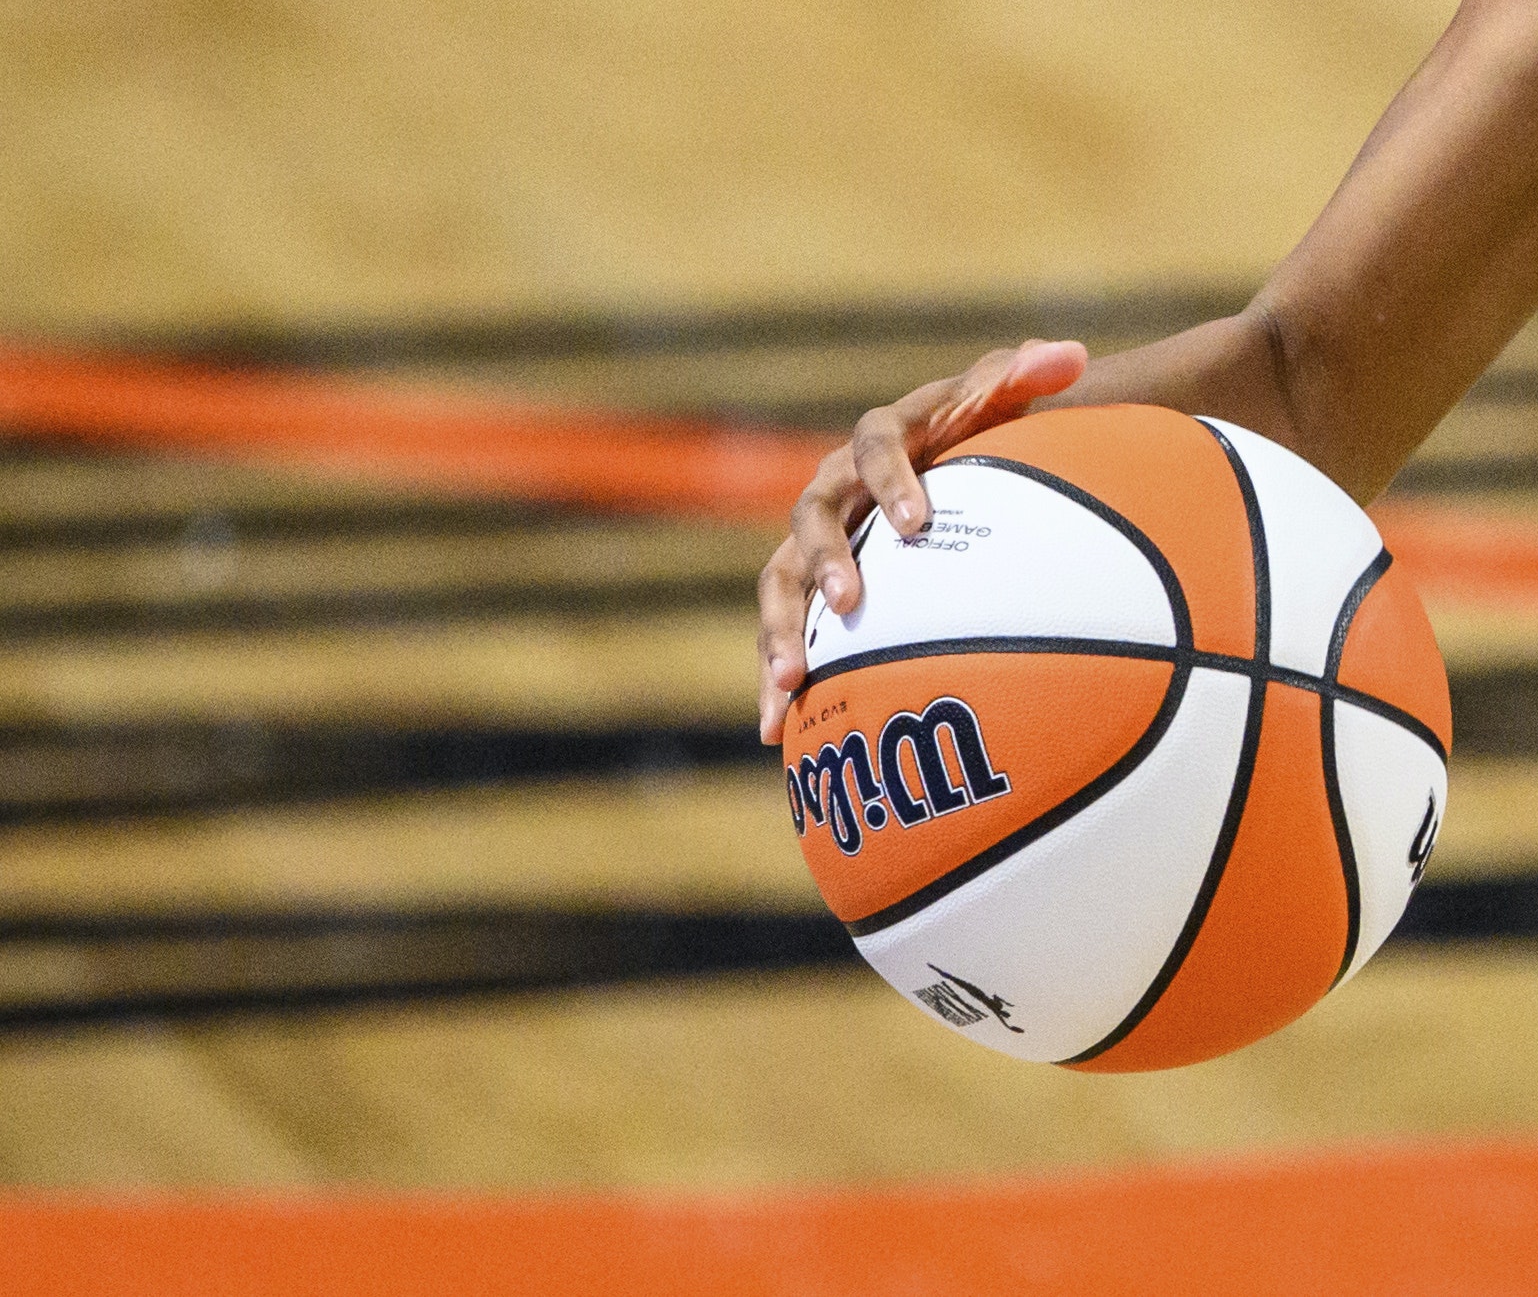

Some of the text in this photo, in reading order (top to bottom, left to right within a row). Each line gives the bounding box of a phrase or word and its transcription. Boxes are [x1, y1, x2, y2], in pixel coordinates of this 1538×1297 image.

[935, 522, 992, 538] GAME
[894, 537, 969, 552] OFFICIAL
[786, 695, 1013, 857] Wilso
